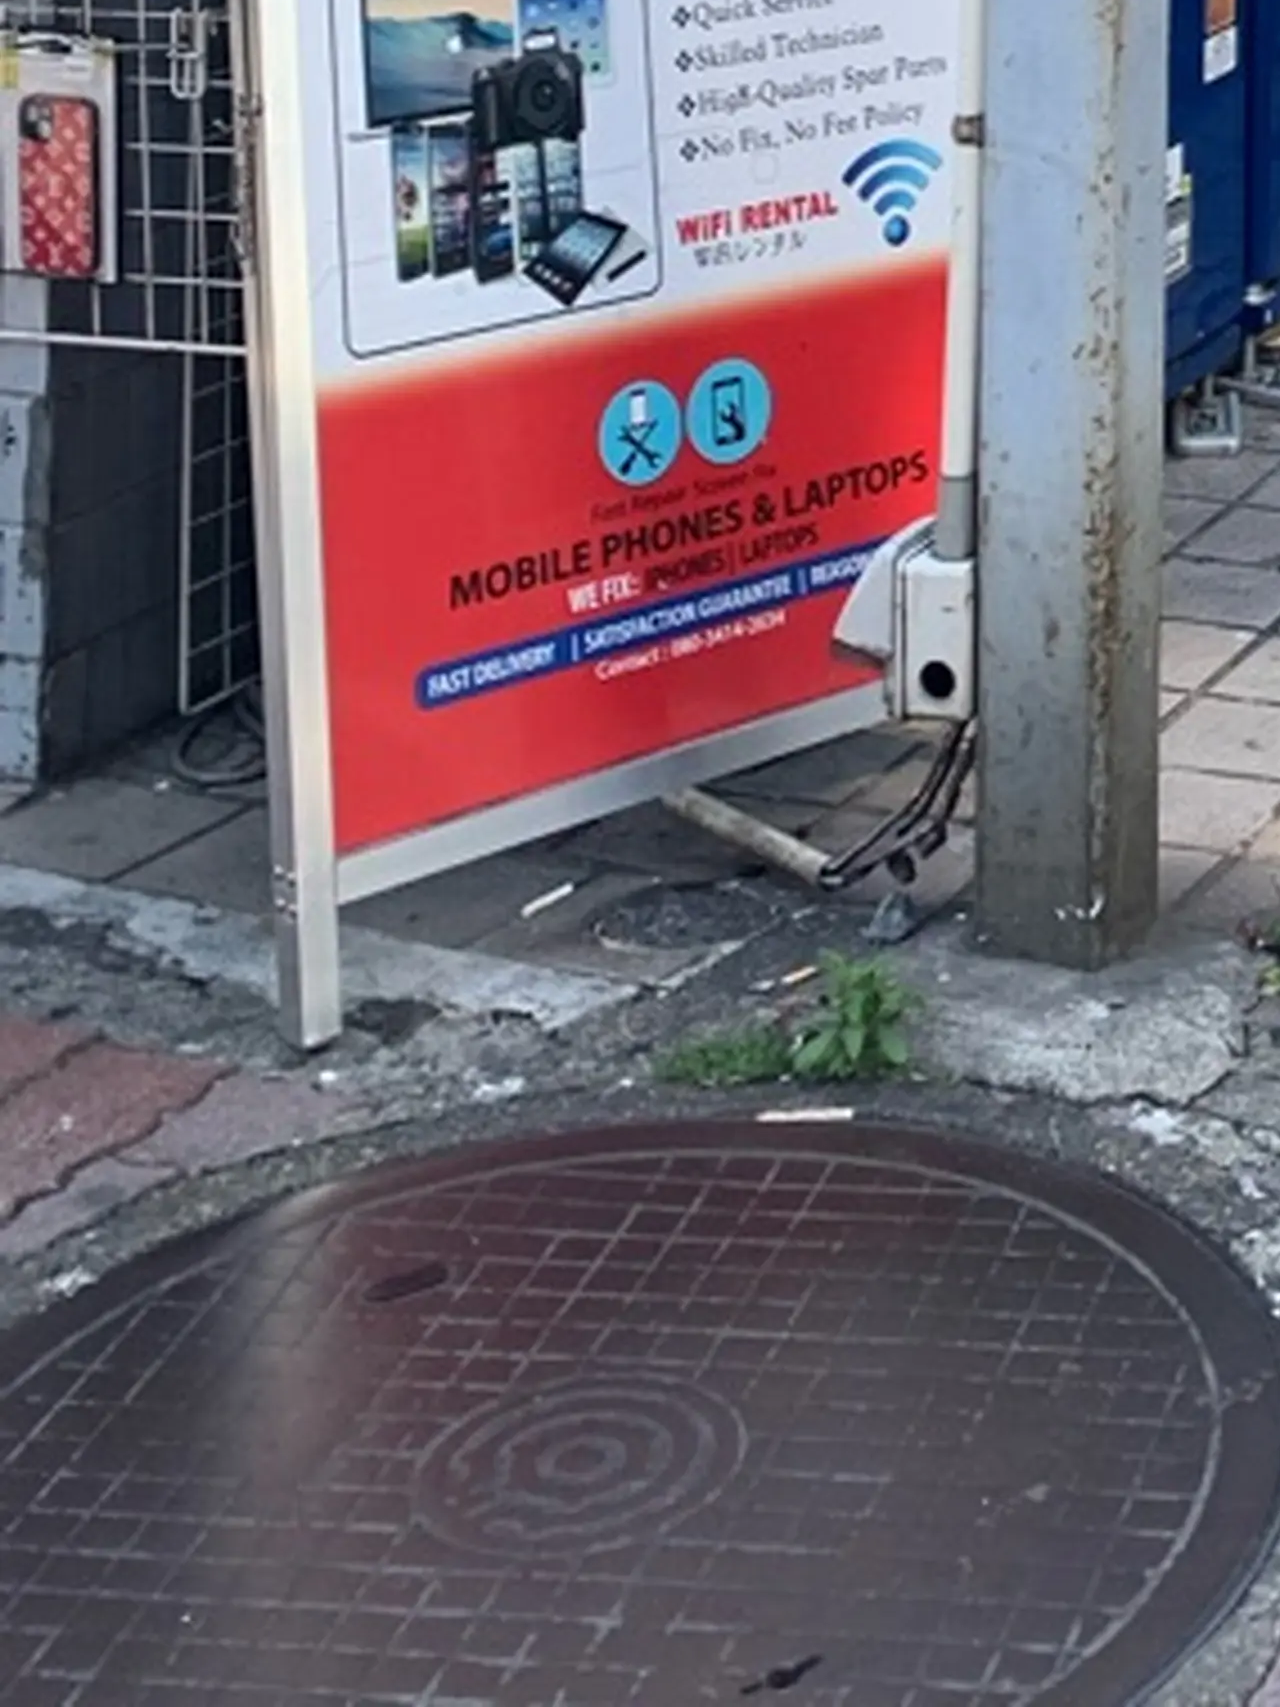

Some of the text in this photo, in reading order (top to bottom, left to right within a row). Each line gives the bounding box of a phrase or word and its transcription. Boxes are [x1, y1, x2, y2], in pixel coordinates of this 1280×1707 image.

[692, 0, 756, 30] Quick
[694, 23, 885, 72] Skilled Technician
[701, 135, 735, 161] No
[738, 190, 840, 234] RENTAL
[449, 449, 929, 611] MOBILE PHONES & LAPTOPS
[566, 582, 601, 614] WE
[740, 522, 819, 565] LAPTOPS
[427, 673, 471, 699] FAST
[473, 640, 557, 686] DELIVERY
